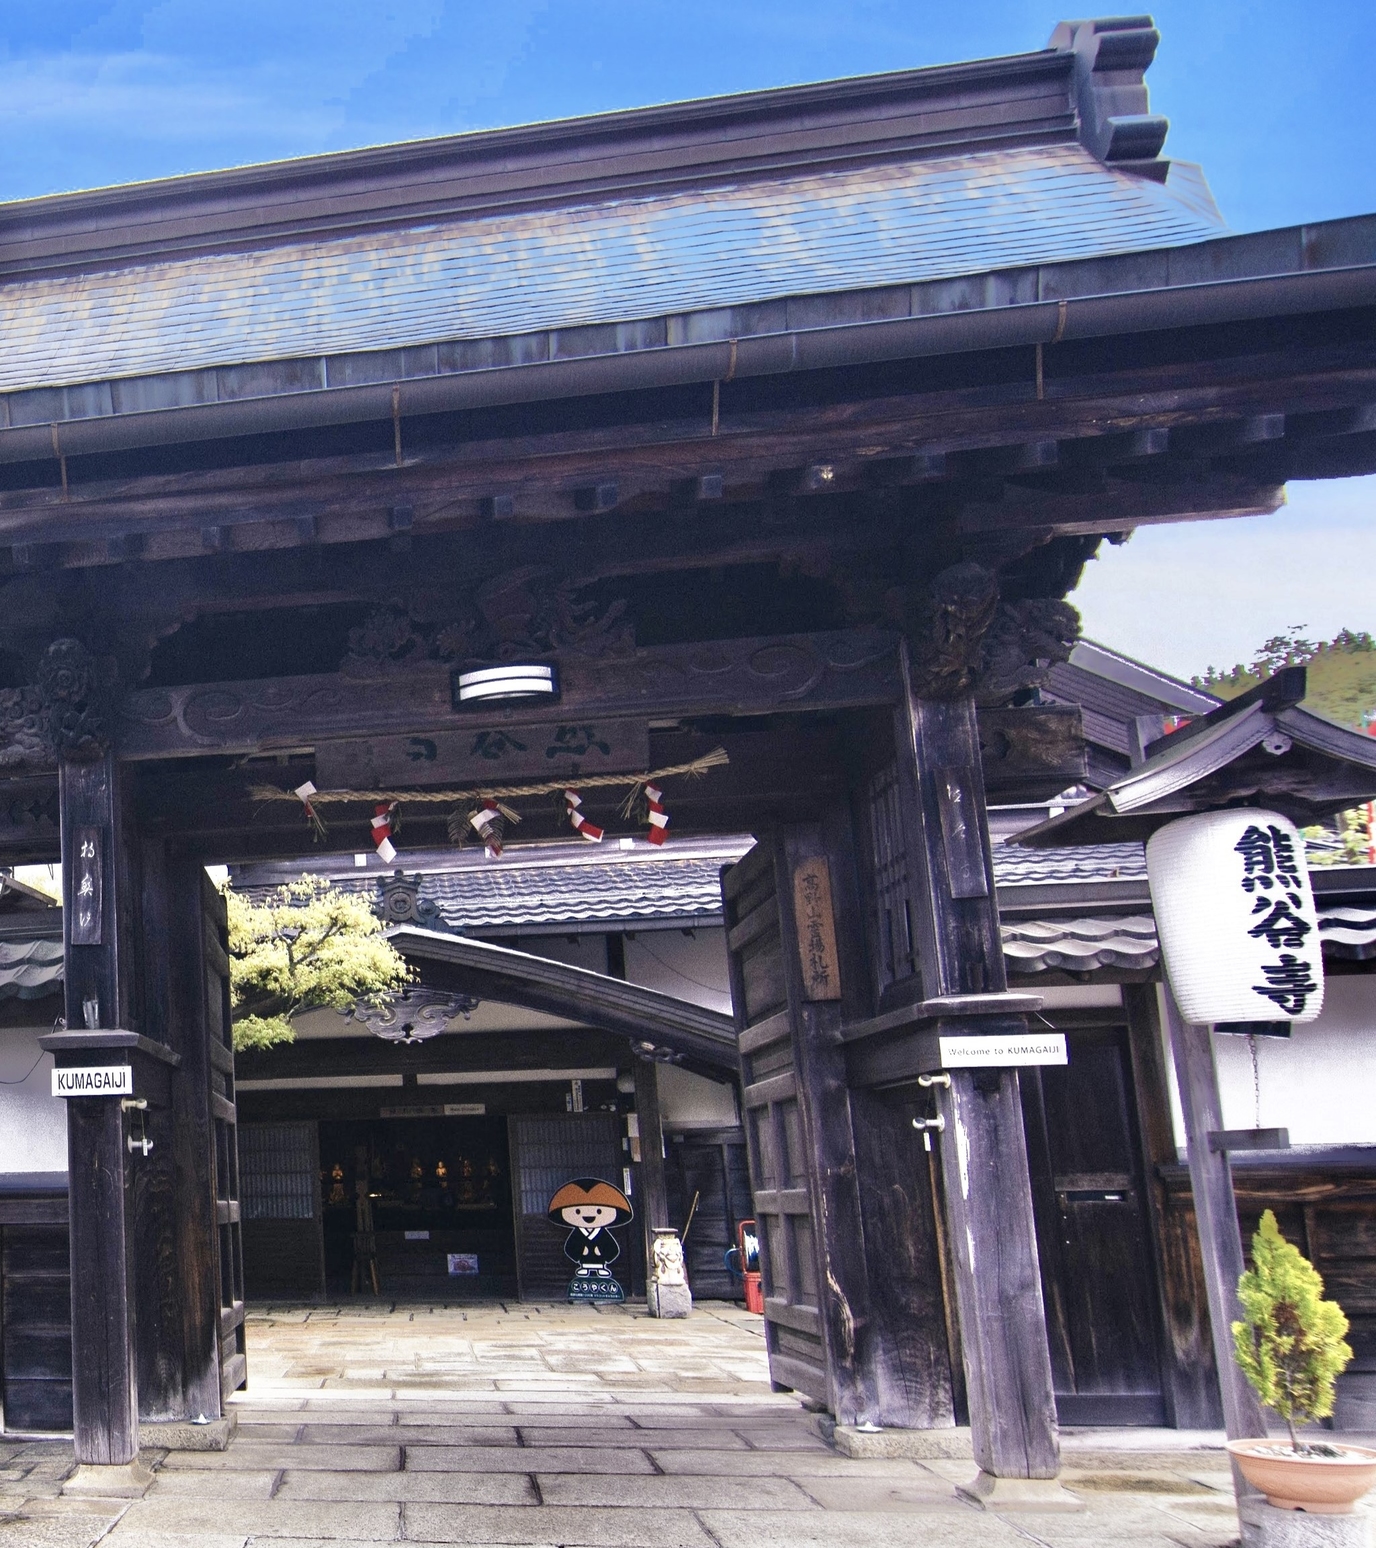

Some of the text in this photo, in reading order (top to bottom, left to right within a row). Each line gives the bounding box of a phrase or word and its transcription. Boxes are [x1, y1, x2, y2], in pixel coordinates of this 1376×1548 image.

[1234, 825, 1318, 1015] 熊谷寺
[948, 1045, 1060, 1057] Welcome to KUMAGAIJI
[57, 1071, 126, 1090] KUMAGAIJI
